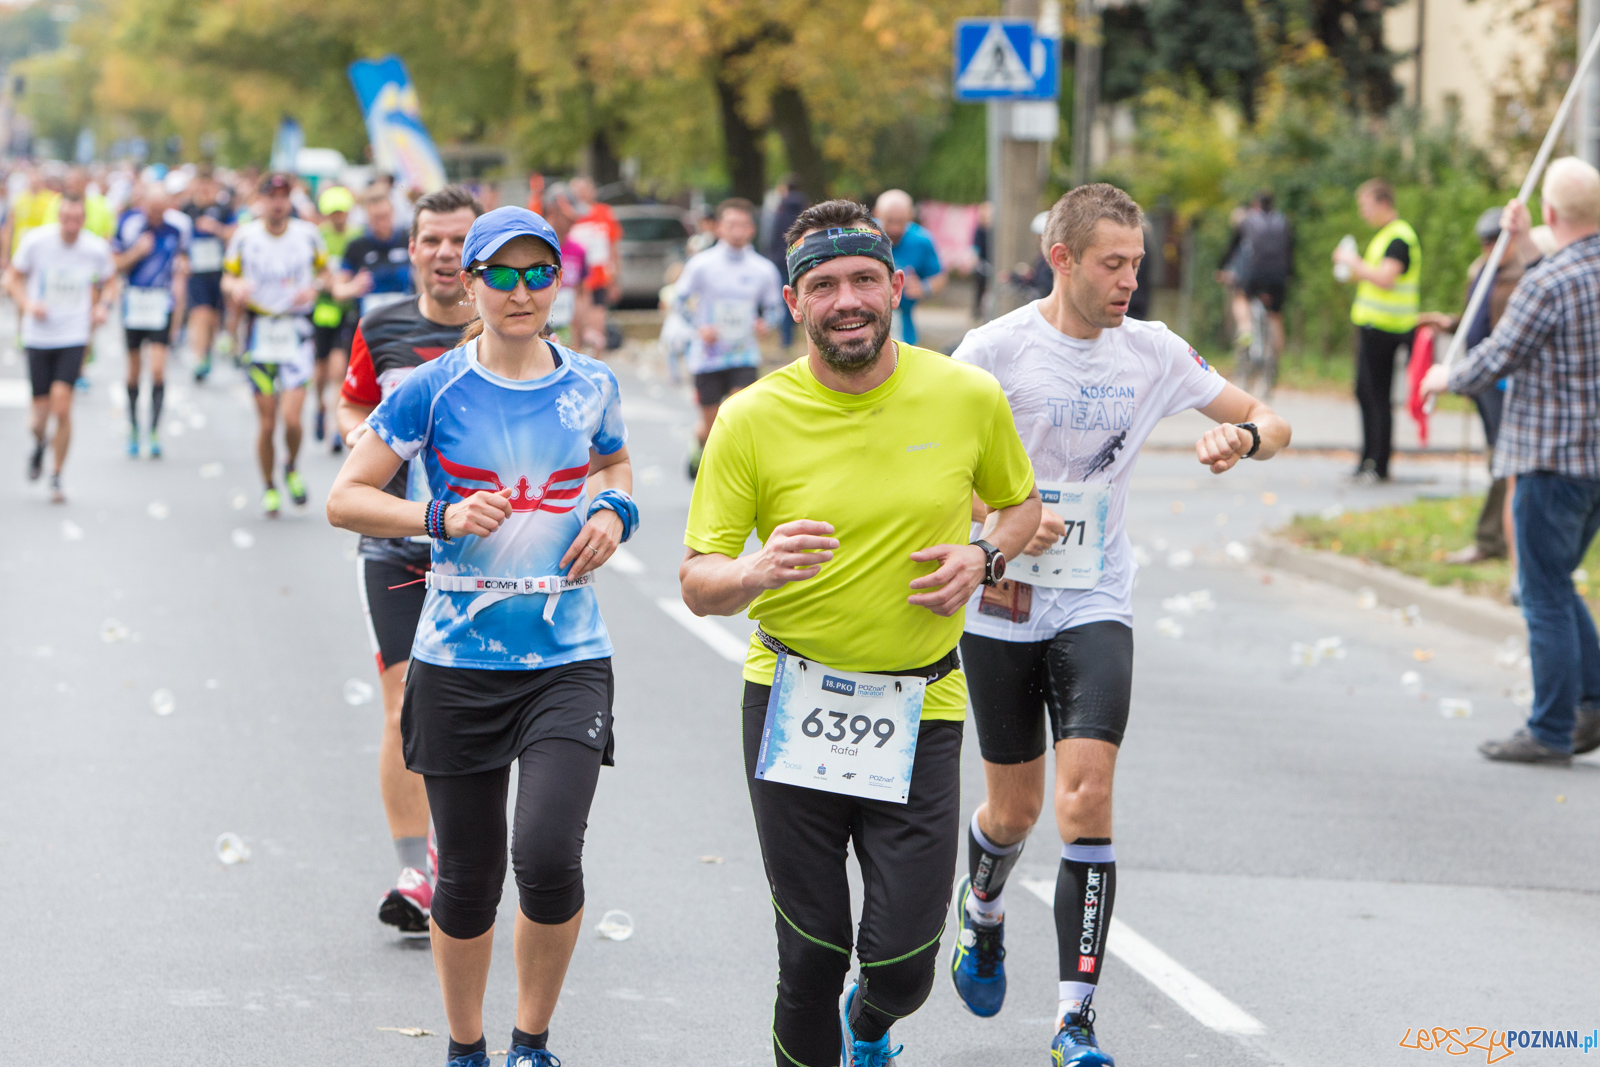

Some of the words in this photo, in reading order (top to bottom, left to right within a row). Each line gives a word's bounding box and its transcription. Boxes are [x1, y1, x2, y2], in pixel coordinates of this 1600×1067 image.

[1080, 384, 1134, 399] KOŚCIAN
[1048, 398, 1135, 430] TEAM
[906, 442, 934, 452] CRAFT
[1061, 520, 1086, 545] 71
[1044, 548, 1066, 556] obert
[825, 680, 836, 689] 18.
[836, 682, 853, 692] PKO
[801, 707, 895, 748] 6399
[830, 744, 859, 757] Rafał
[842, 772, 857, 780] 4F
